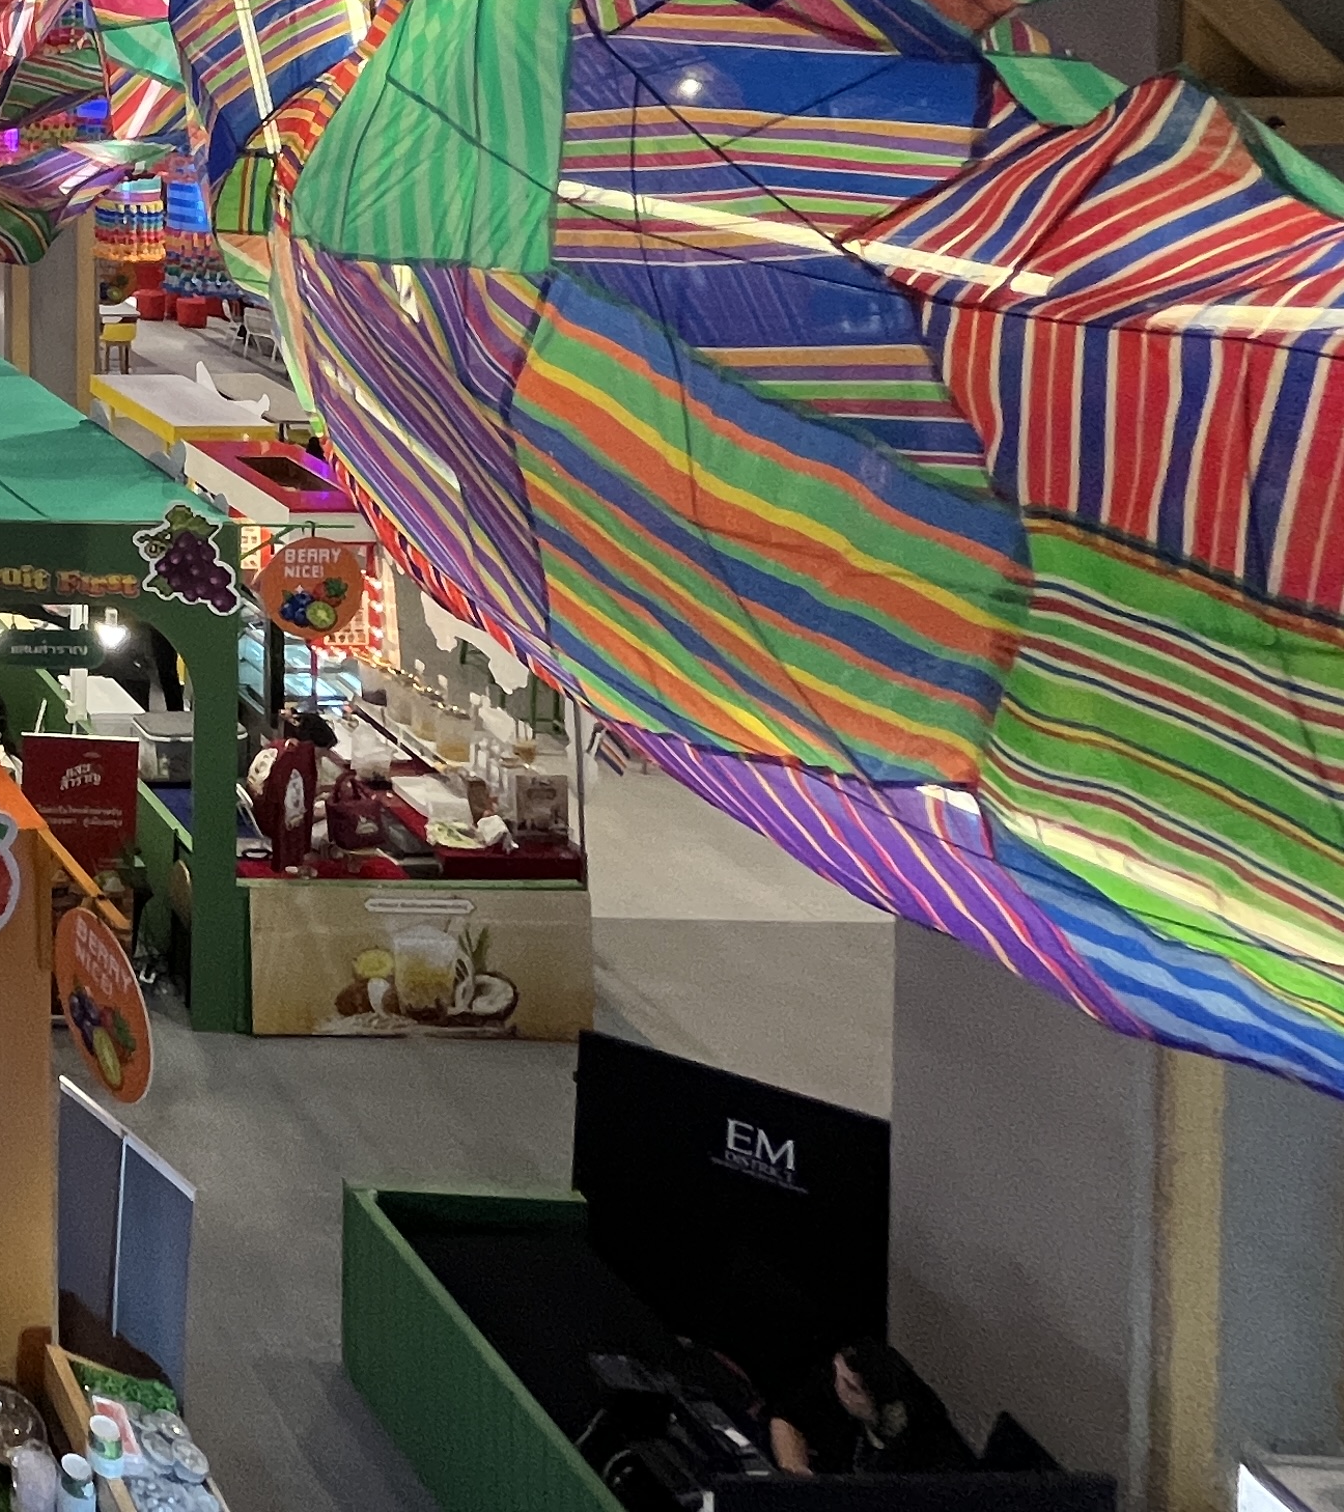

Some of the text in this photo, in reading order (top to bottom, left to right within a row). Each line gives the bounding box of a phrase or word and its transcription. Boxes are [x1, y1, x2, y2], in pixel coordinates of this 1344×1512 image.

[283, 548, 342, 564] BERRY
[55, 569, 141, 598] First
[283, 564, 324, 579] NICE!
[75, 915, 133, 995] BERRY
[726, 1117, 796, 1171] EM
